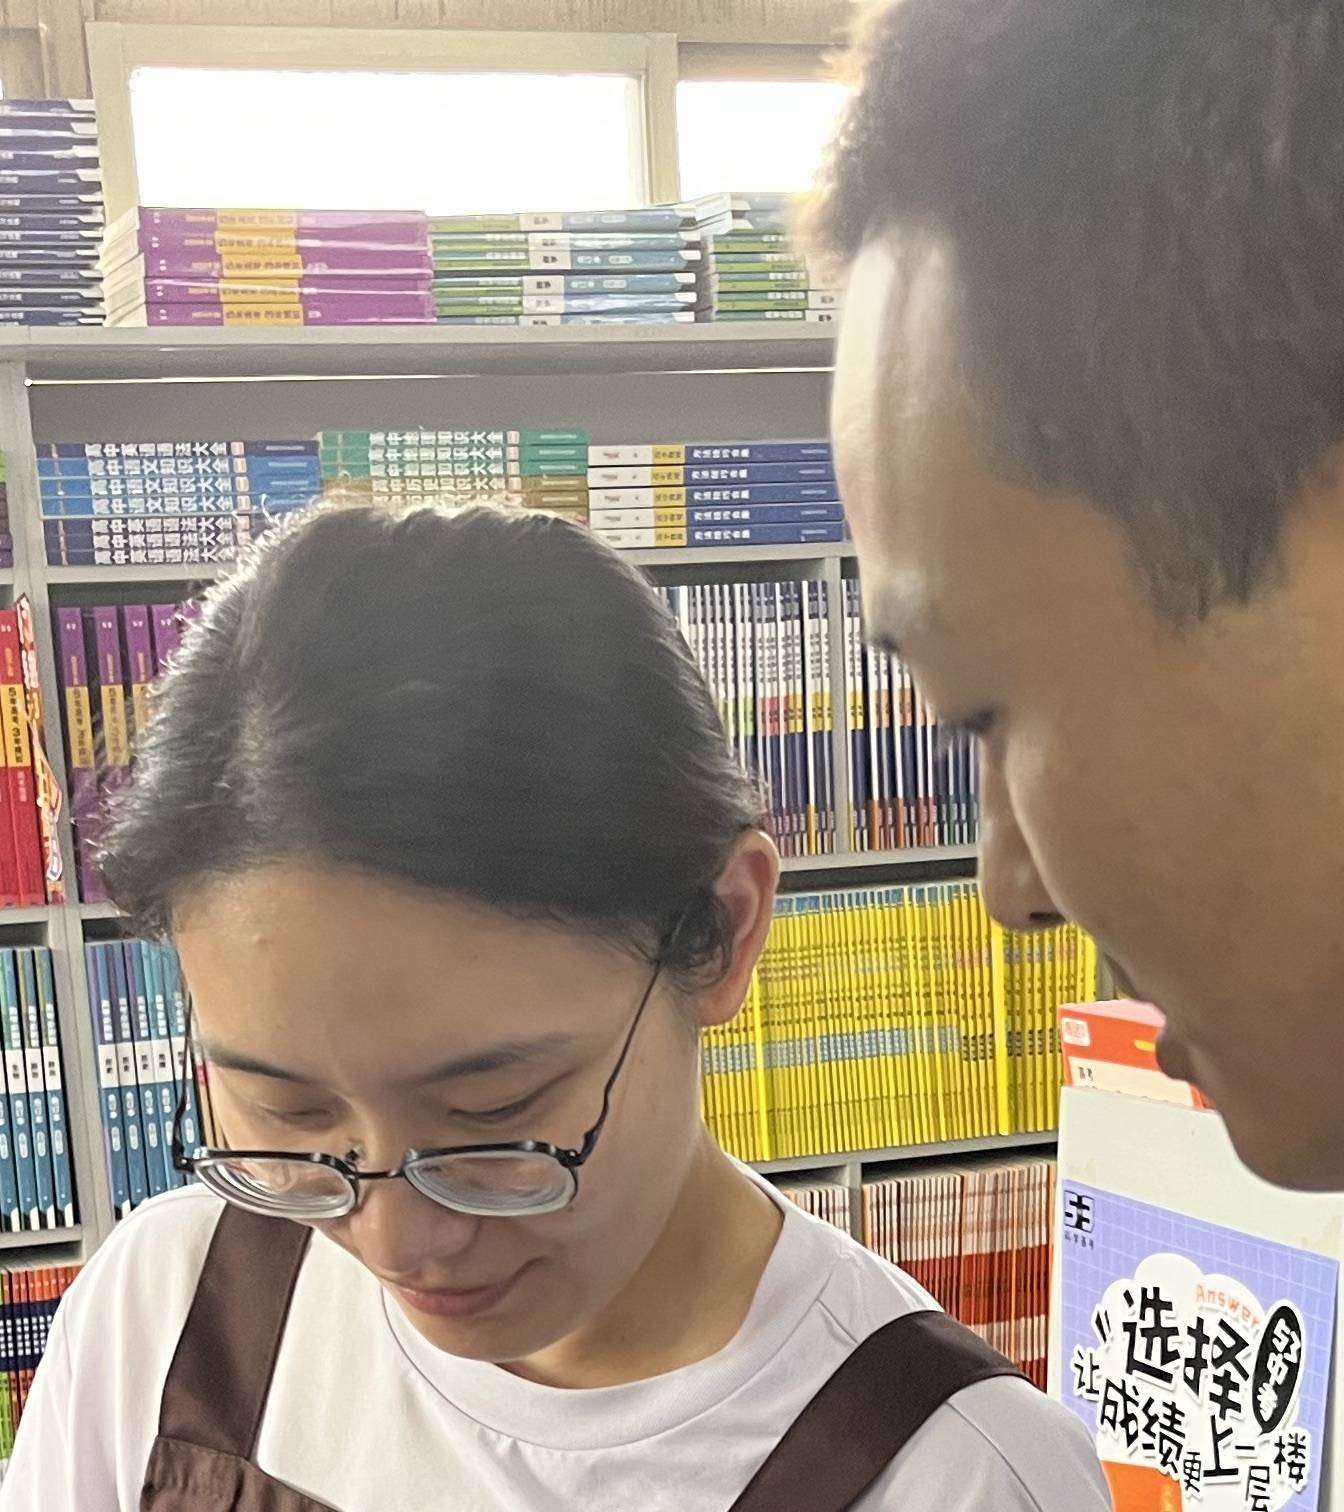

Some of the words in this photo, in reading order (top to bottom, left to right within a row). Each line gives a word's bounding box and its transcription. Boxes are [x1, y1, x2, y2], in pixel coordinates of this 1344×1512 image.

[88, 458, 230, 476] 高中语文知识大全
[91, 477, 232, 495] 高中语文知识大全
[92, 496, 233, 515] 高中语文知识大全
[1122, 1286, 1250, 1420] 选择
